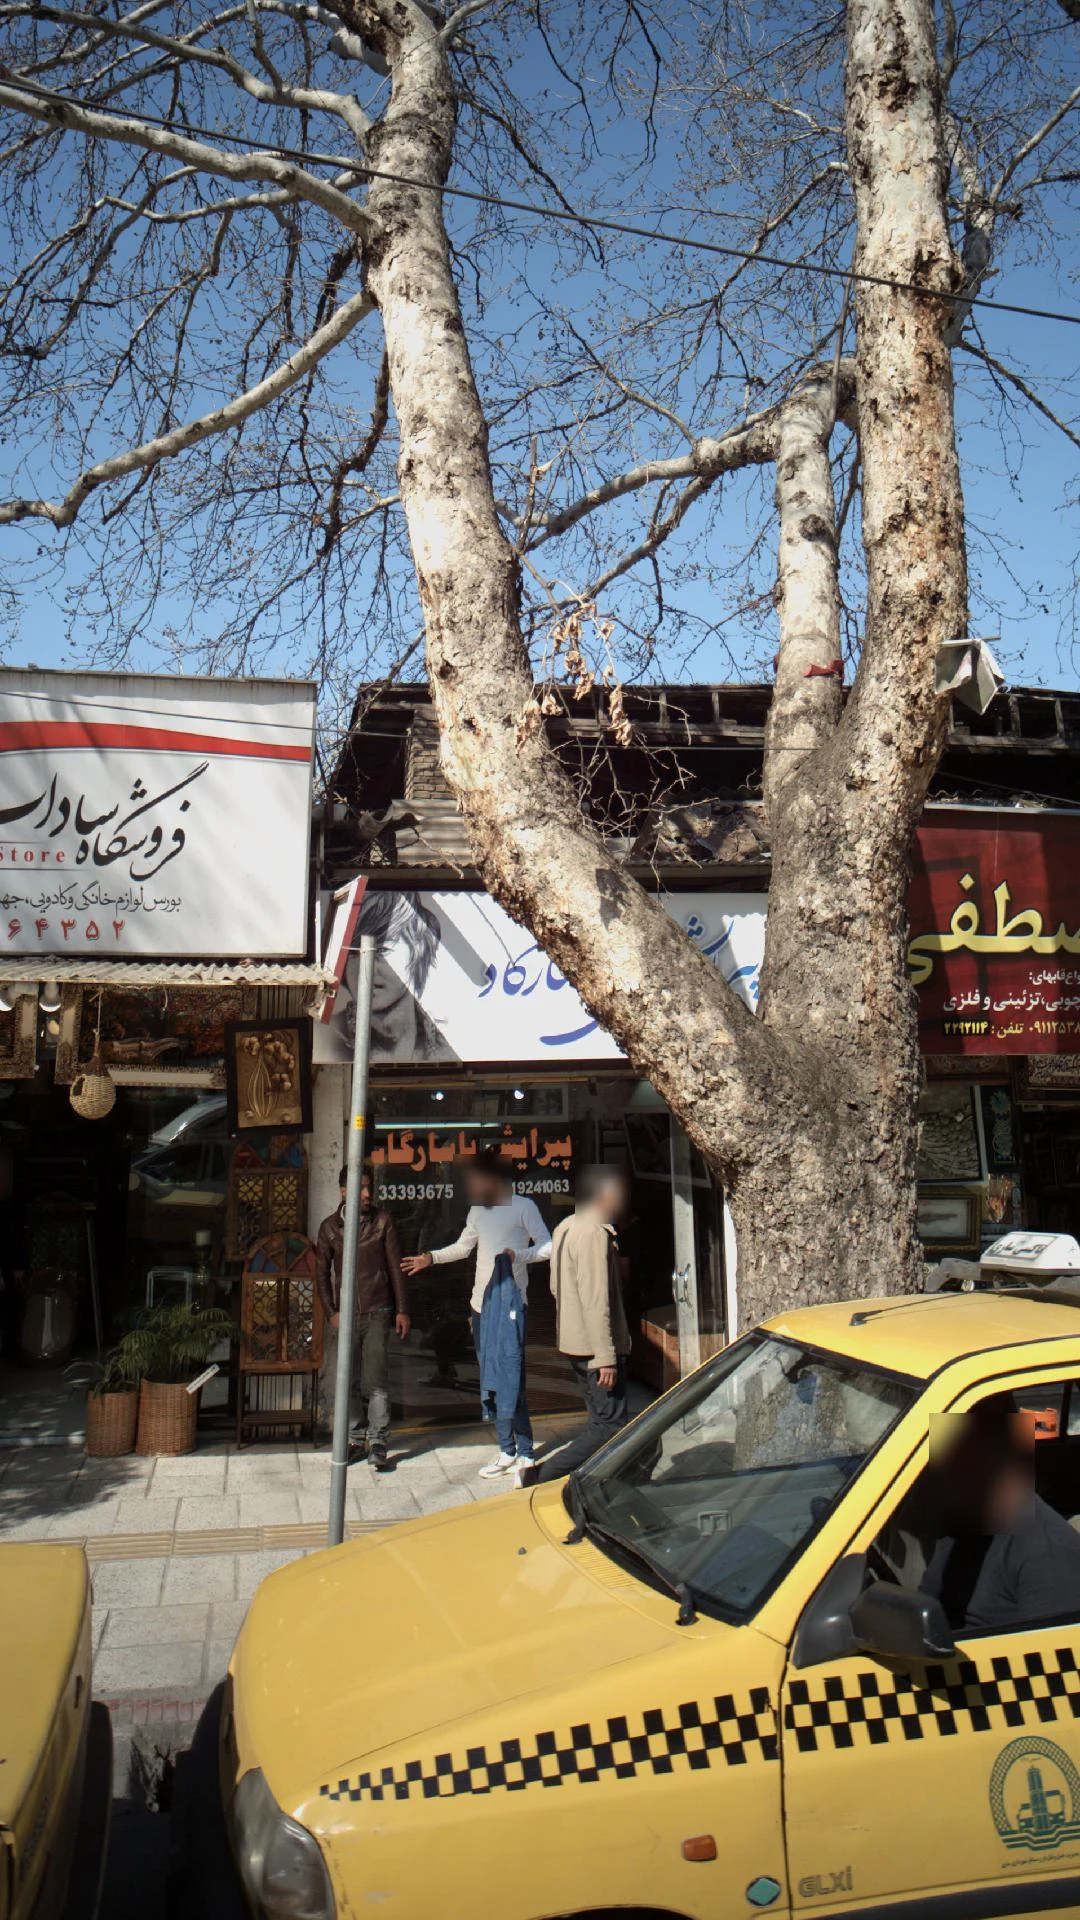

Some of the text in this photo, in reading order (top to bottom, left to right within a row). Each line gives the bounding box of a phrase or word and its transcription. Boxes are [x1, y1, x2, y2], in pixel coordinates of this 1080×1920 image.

[76, 760, 209, 881] فروشگاه
[74, 880, 114, 910] خانگی
[115, 885, 144, 917] لوازم
[143, 894, 181, 912] بورس
[943, 989, 980, 1011] فلزی
[982, 996, 991, 1011] و
[378, 1184, 454, 1201] 33393675
[511, 1179, 570, 1195] 19241063
